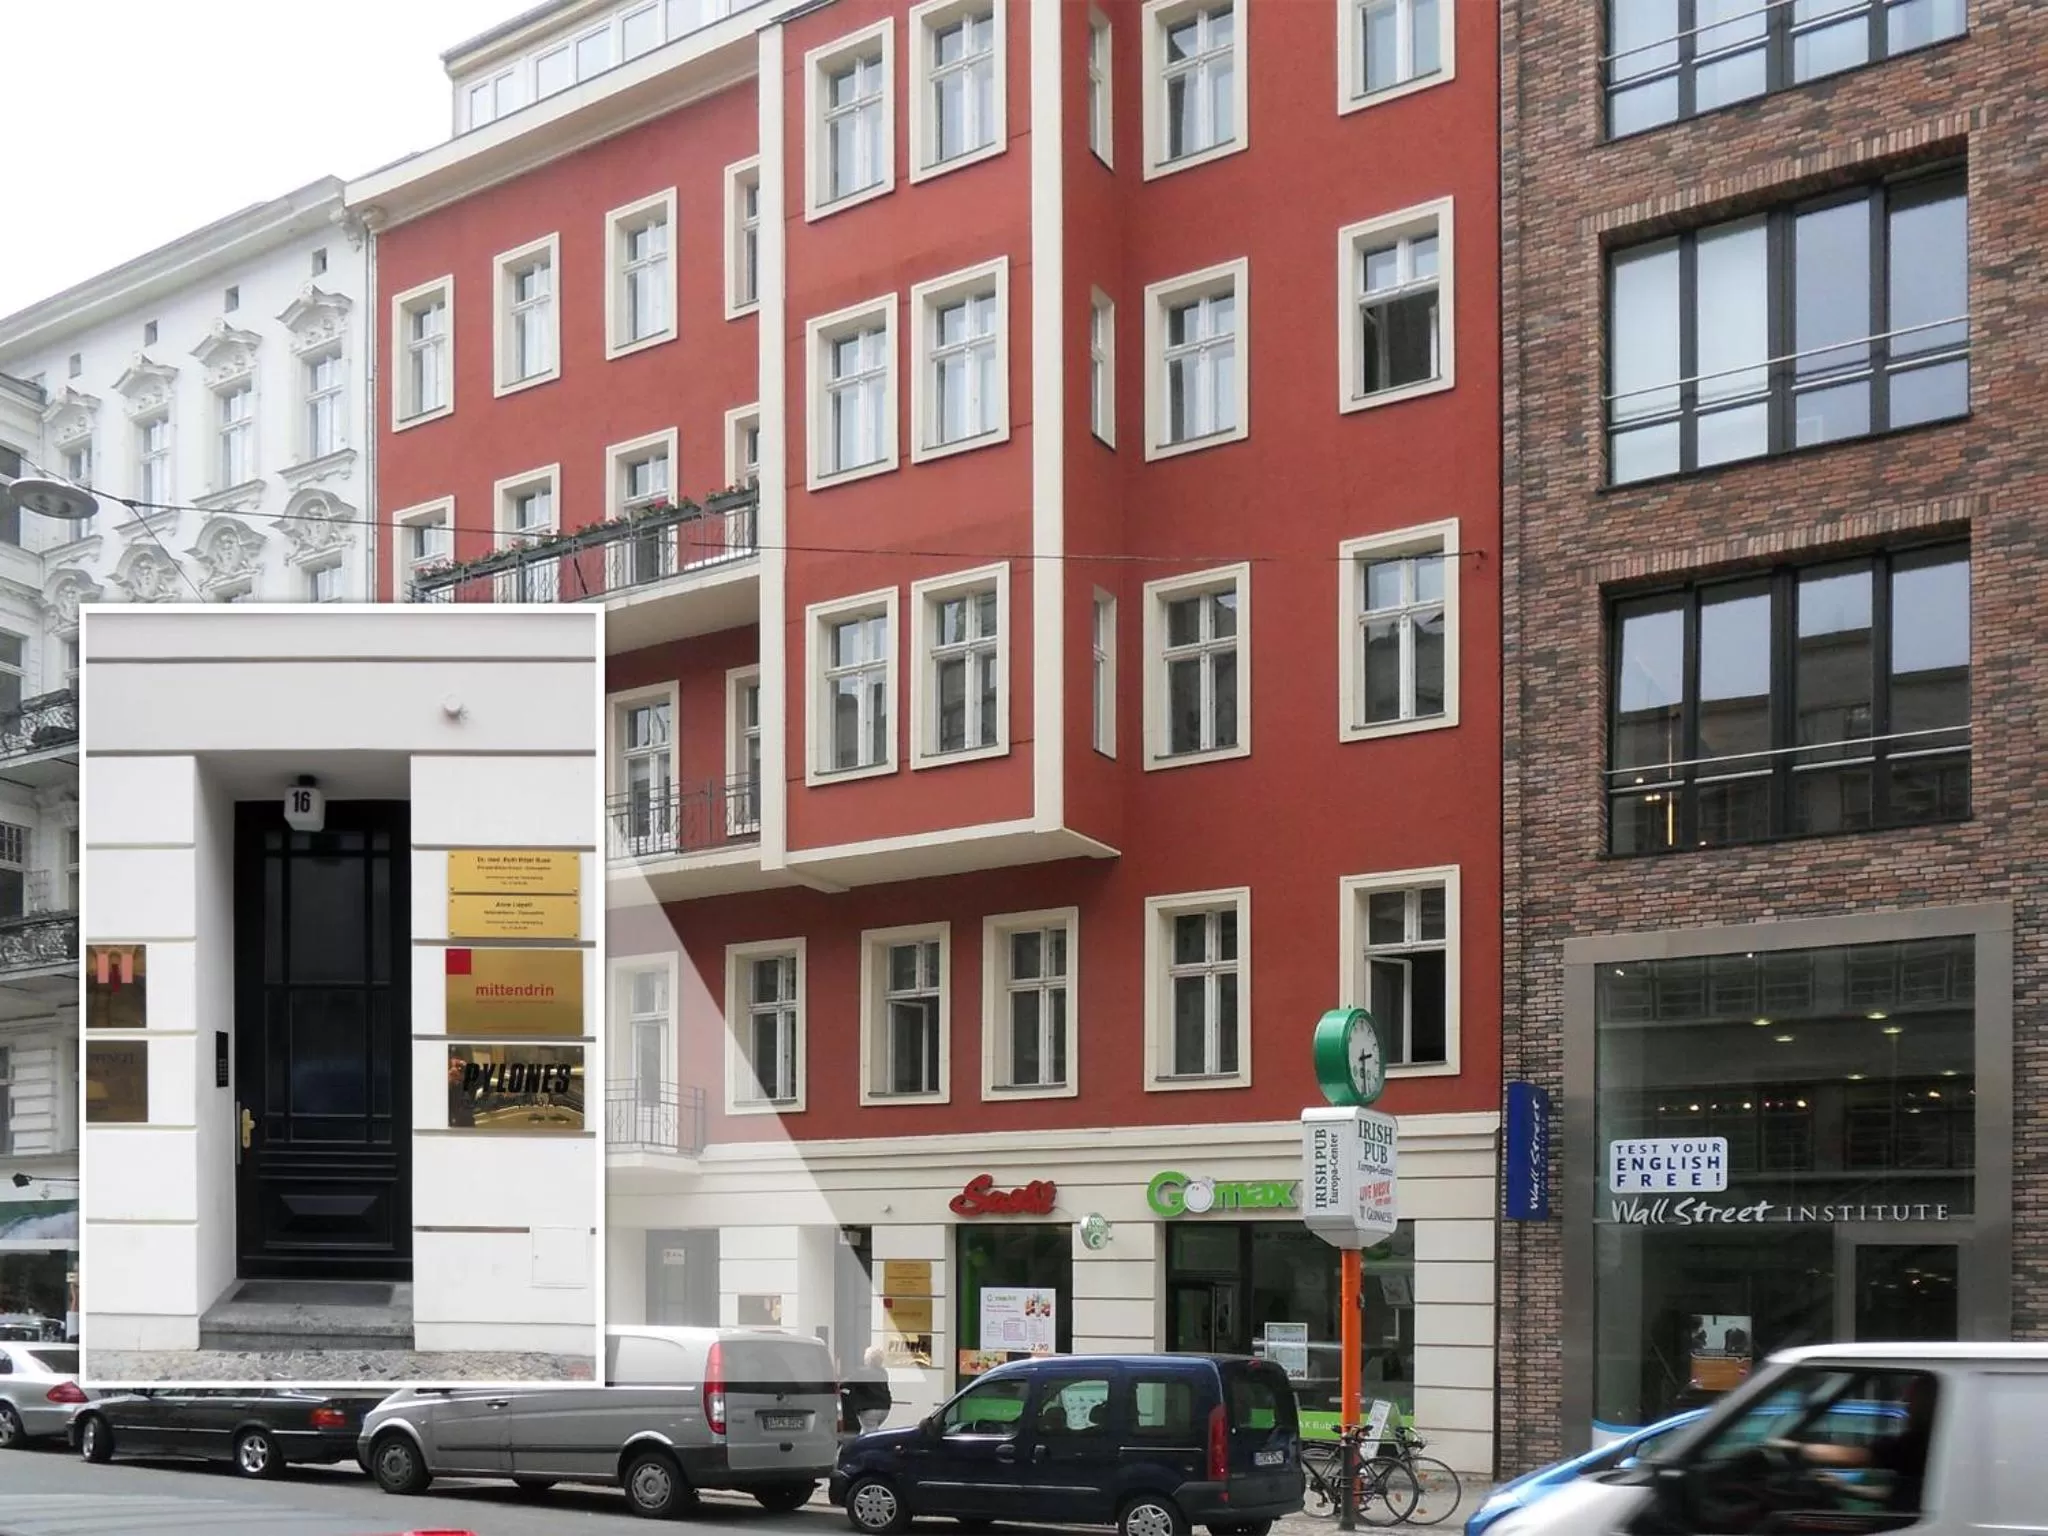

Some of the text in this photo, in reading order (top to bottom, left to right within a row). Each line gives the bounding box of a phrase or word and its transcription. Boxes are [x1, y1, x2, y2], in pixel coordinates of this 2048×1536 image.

[292, 790, 311, 813] 16
[476, 984, 554, 997] mittendrin
[463, 1063, 572, 1093] PYLONES
[1358, 1119, 1393, 1146] IRISH
[1363, 1141, 1389, 1164] PUB
[1530, 1097, 1540, 1210] Wall Street
[1616, 1143, 1721, 1154] TEST YOUR
[1315, 1128, 1328, 1208] IRISH PUB
[1329, 1133, 1341, 1204] Europa-Center
[1617, 1156, 1720, 1171] ENGLISH
[1612, 1197, 1949, 1226] Wall Street INSTITUTE
